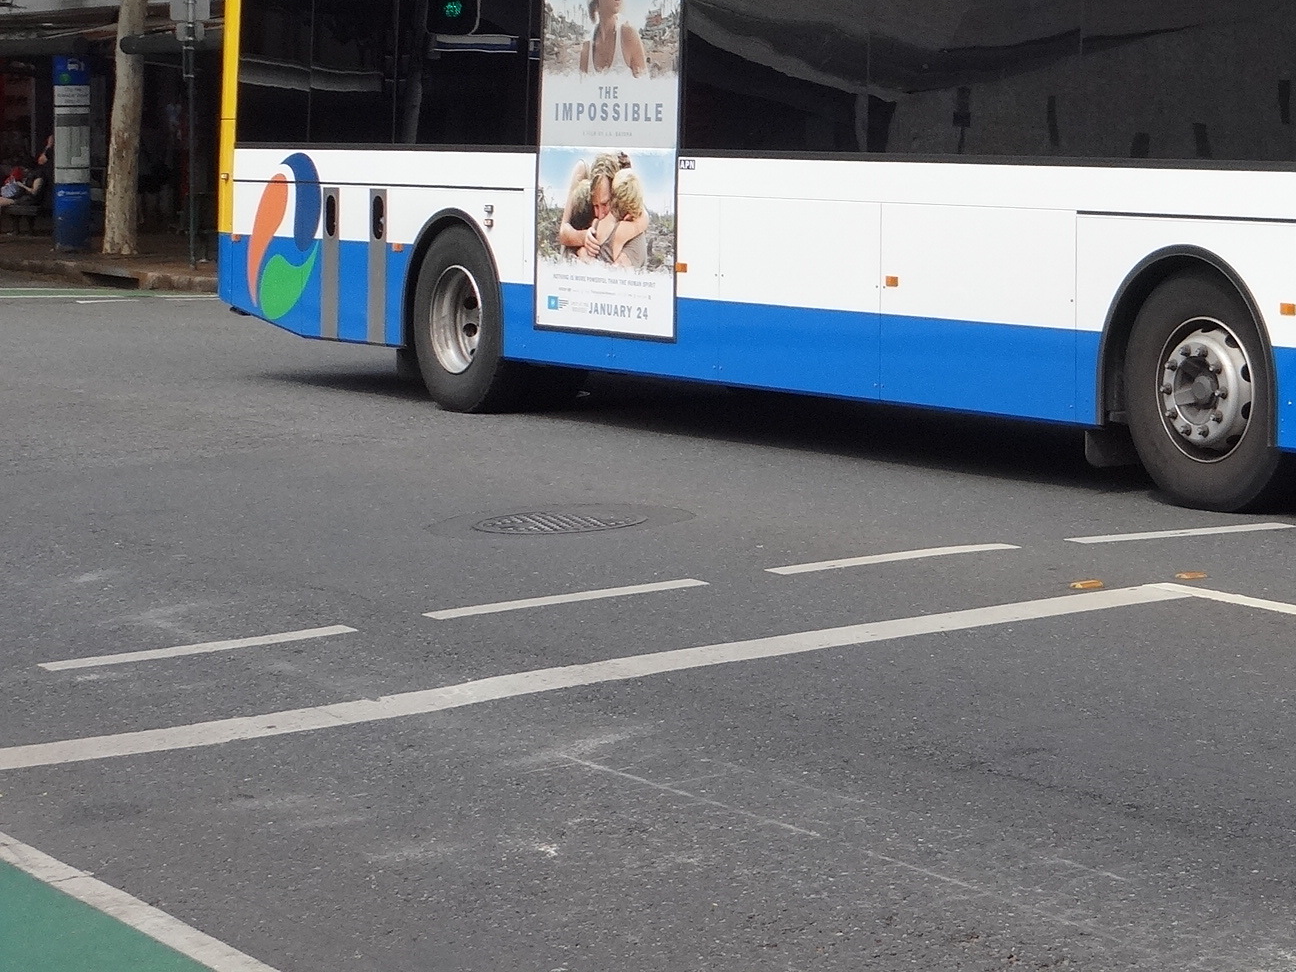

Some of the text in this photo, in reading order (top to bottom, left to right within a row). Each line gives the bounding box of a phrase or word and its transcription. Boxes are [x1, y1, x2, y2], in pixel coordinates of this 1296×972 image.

[598, 86, 619, 99] THE
[555, 102, 664, 122] IMPOSSIBLE
[680, 160, 694, 169] APN
[589, 302, 632, 318] JANUARY
[636, 306, 649, 320] 24
